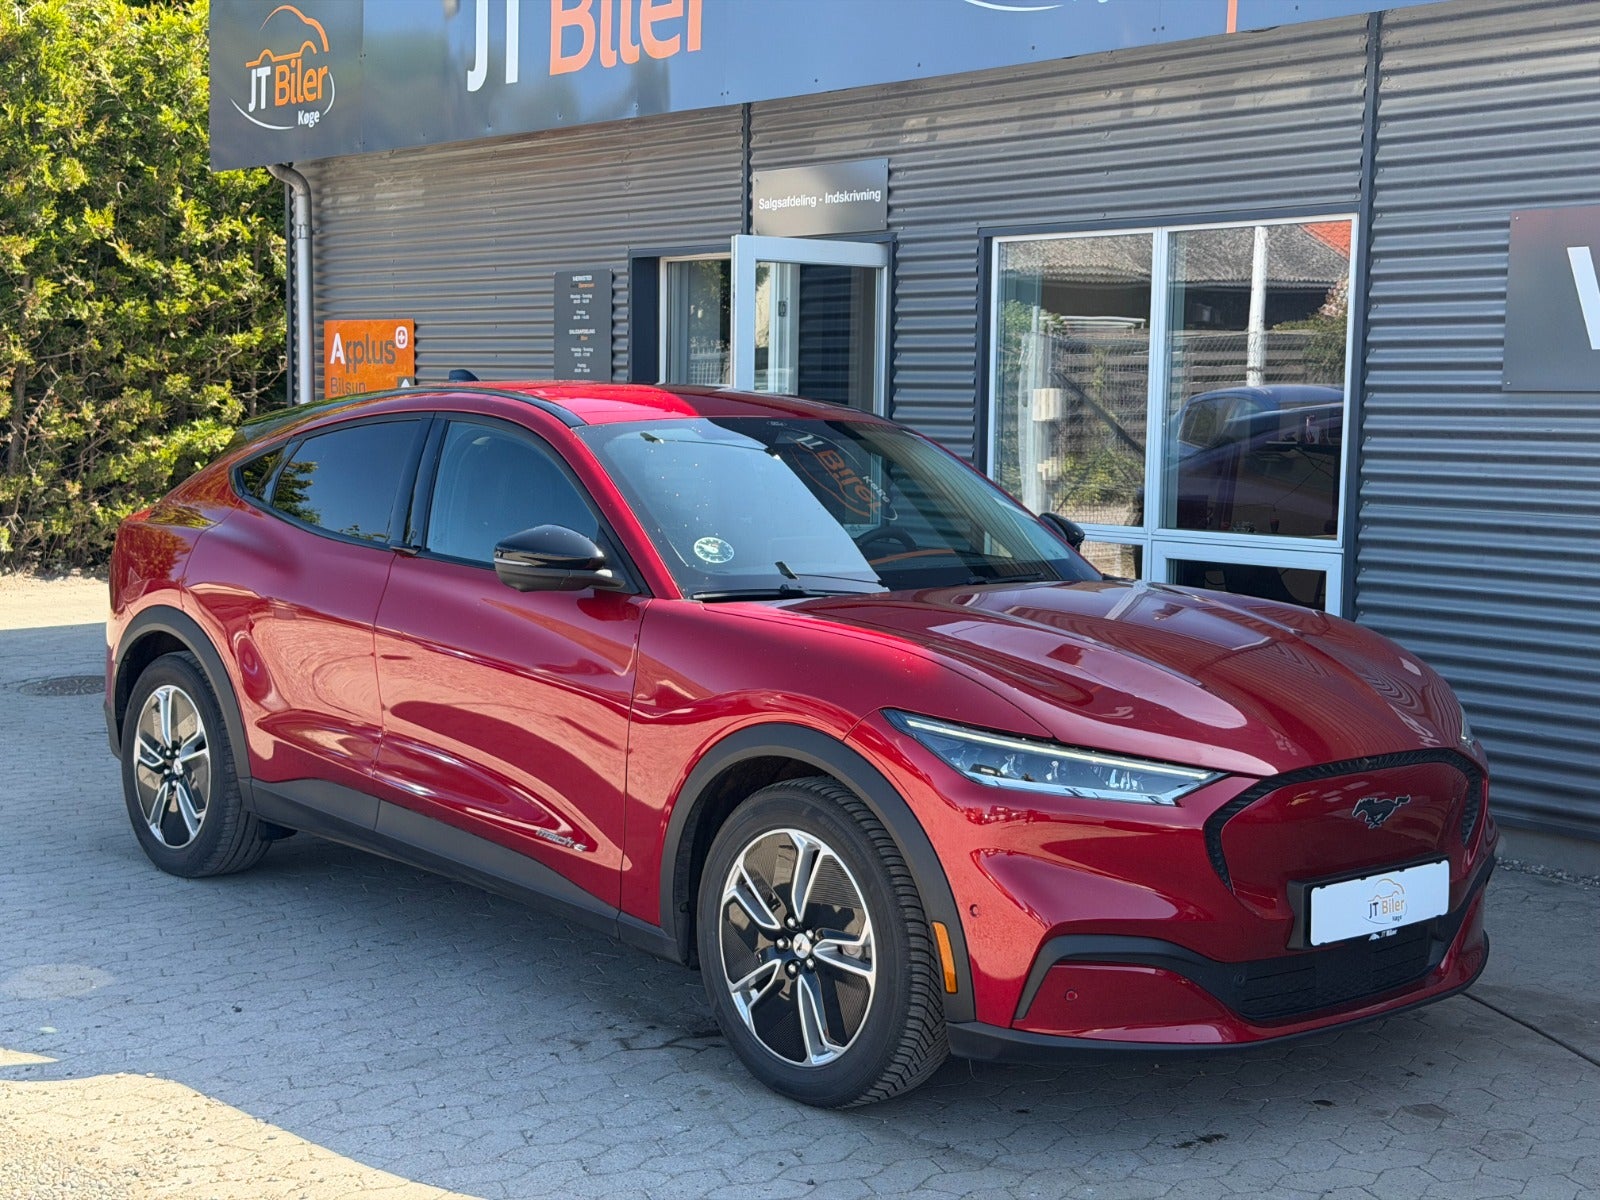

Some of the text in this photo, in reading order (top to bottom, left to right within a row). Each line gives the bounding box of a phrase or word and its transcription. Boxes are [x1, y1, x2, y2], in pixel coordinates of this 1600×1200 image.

[248, 58, 329, 113] JT Biler
[297, 109, 320, 128] Køge
[759, 195, 817, 210] Salgsafdeling
[825, 188, 881, 205] Indskrivning
[1369, 898, 1404, 918] JT Biler
